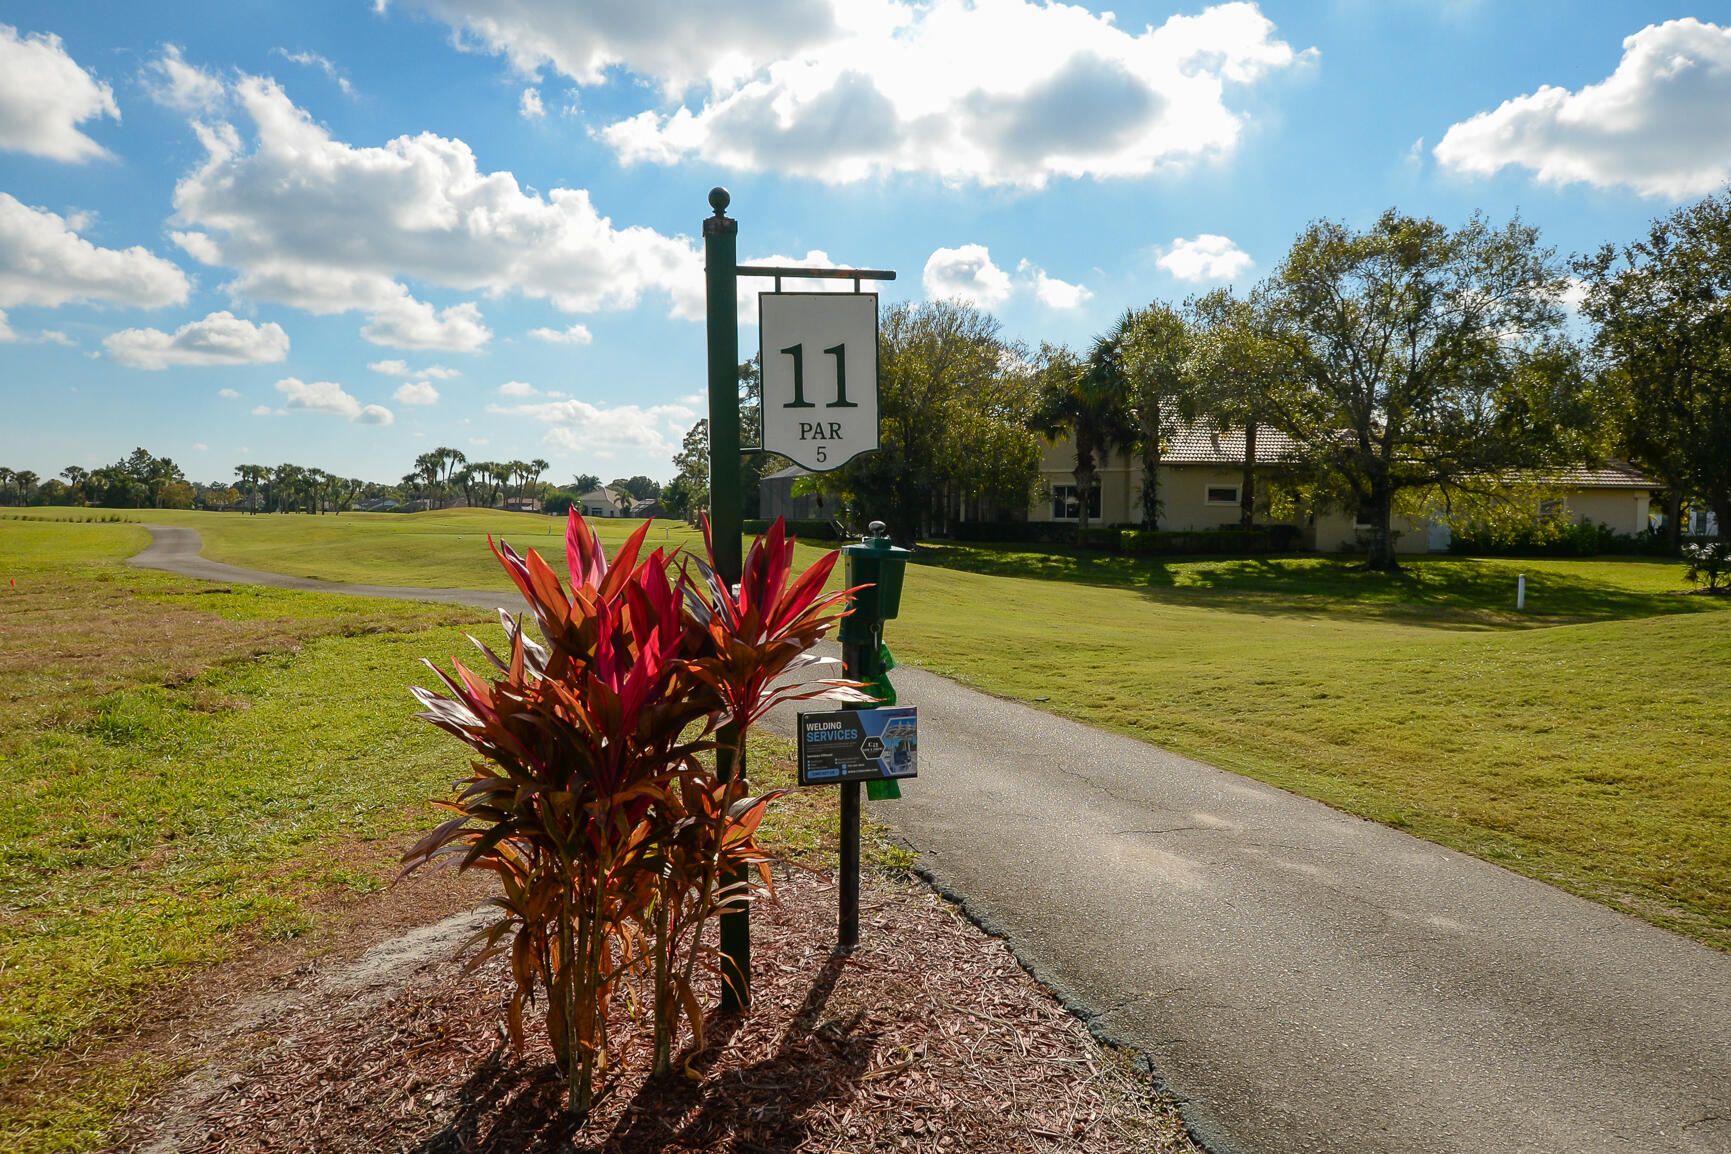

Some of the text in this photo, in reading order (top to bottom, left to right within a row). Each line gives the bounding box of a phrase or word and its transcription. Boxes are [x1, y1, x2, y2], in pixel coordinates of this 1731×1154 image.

[780, 343, 858, 408] 11
[799, 422, 843, 440] PAR
[816, 446, 827, 463] 5
[806, 721, 842, 731] WELDING
[806, 729, 858, 743] SERVICES
